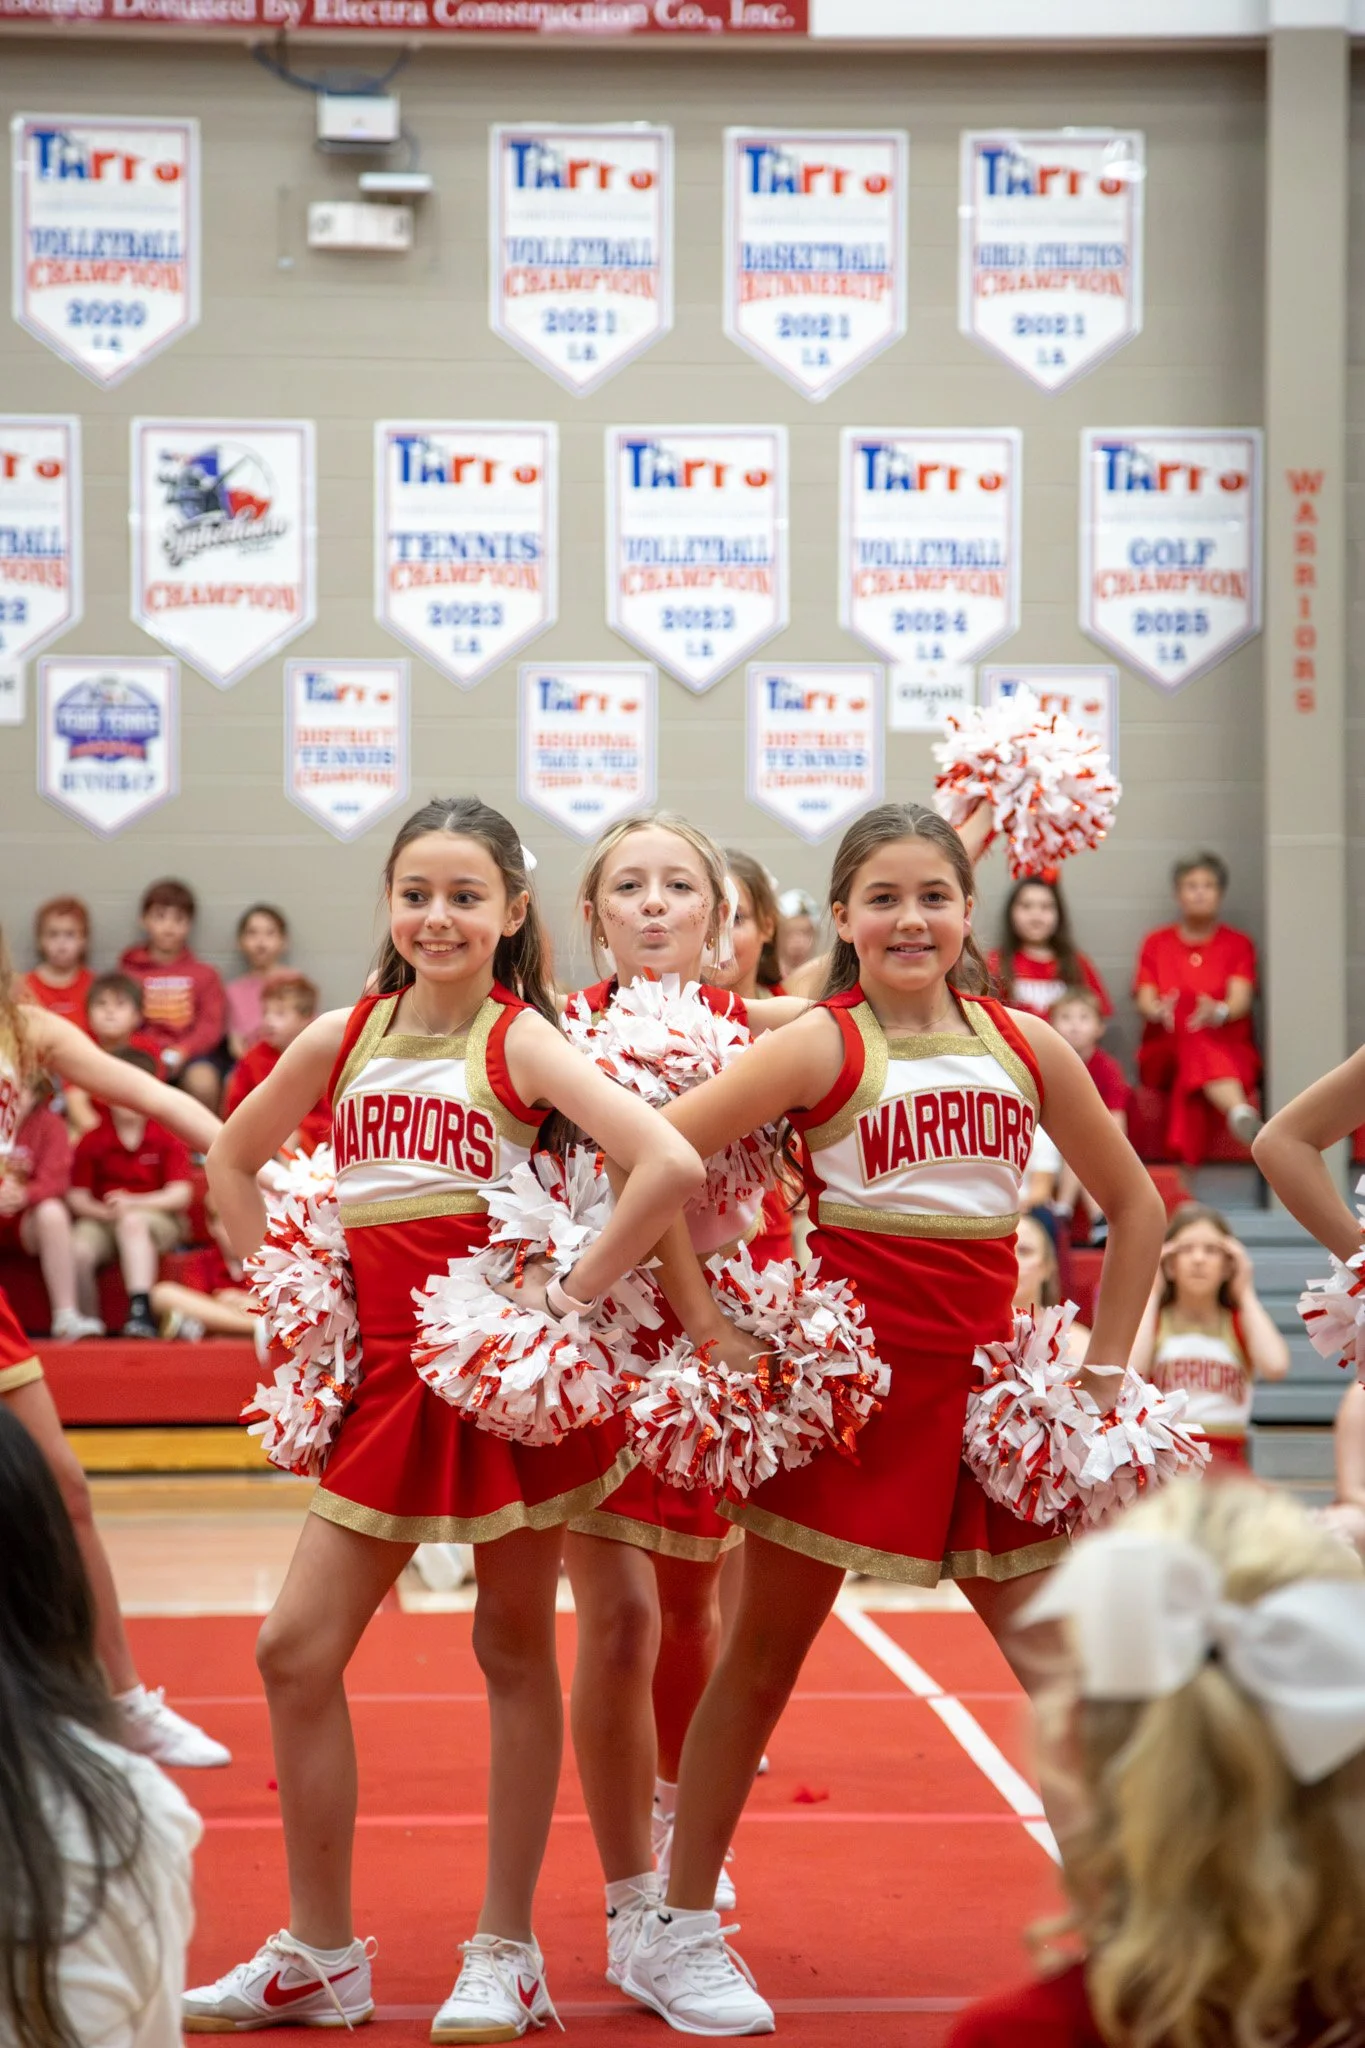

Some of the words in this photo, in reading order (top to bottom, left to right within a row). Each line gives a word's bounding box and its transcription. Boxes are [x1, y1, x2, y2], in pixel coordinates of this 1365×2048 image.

[111, 0, 257, 20] Donated
[263, 0, 306, 28] by
[313, 0, 428, 25] Electra
[433, 0, 648, 28] Construction
[729, 2, 796, 28] Inc.
[30, 229, 183, 260] VOLLEYBALL
[506, 237, 657, 267] VOLLEYBALL
[742, 242, 892, 271] BASKETBALL
[26, 260, 183, 291] CHAMPION
[503, 268, 657, 299] CHAMPION
[975, 271, 1129, 299] CHAMPION
[66, 300, 149, 328] 2020
[541, 307, 618, 335] 2021
[774, 312, 852, 339] 2021
[1011, 312, 1086, 338] 2021
[390, 531, 541, 562] TENNIS
[622, 537, 772, 563] VOLLEYBALL
[857, 538, 1007, 568] VOLLEYBALL
[1127, 537, 1214, 566] GOLF
[387, 563, 541, 594] CHAMPION
[619, 566, 772, 597] CHAMPION
[852, 568, 1007, 598] CHAMPION
[1094, 568, 1247, 600] CHAMPION
[1284, 468, 1325, 714] WARRIORS
[143, 582, 299, 614] CHAMPION
[333, 1094, 494, 1180] WARRIORS
[859, 1091, 1034, 1180] WARRIORS
